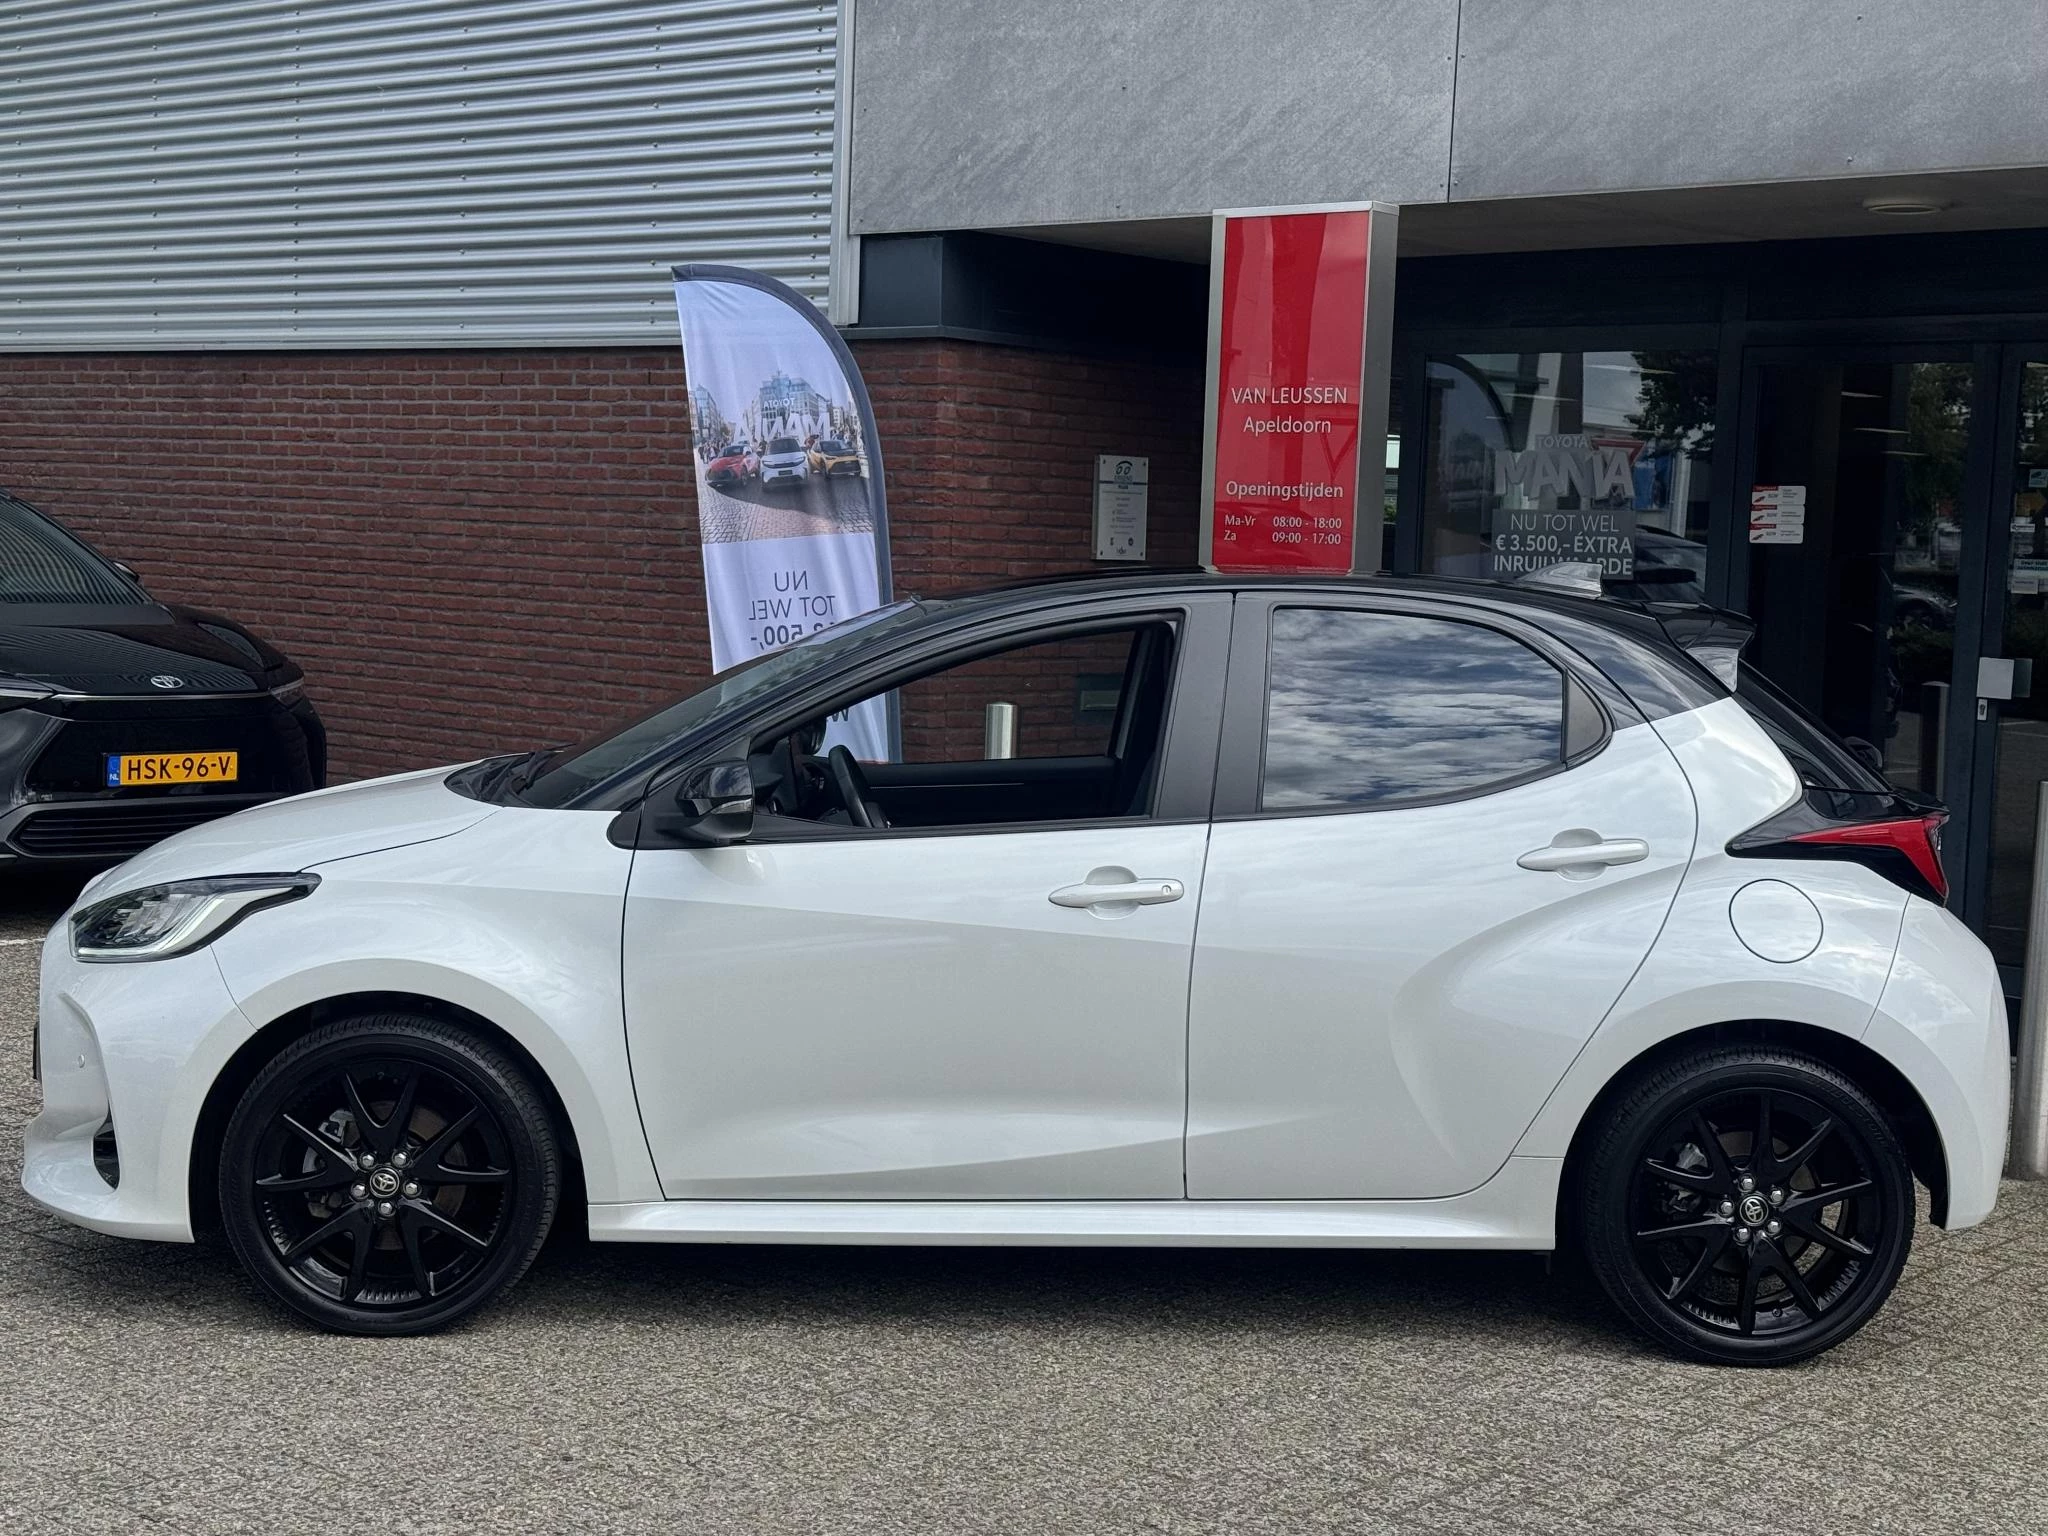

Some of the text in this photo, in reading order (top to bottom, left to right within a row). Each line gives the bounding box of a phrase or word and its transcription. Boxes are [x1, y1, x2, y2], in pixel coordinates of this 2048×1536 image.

[1231, 387, 1347, 404] VAN LEUSSEN
[1243, 416, 1331, 436] Apeldoorn
[1536, 435, 1589, 448] TOYOTA
[1495, 450, 1635, 499] MANIA
[1226, 481, 1343, 500] Openingstijden
[1224, 514, 1256, 527] Ma-Vr
[1272, 516, 1303, 528] 08:00
[1313, 517, 1342, 529] 18:00
[1510, 514, 1620, 532] NU TOT WEL
[1224, 530, 1237, 541] Za
[1272, 531, 1301, 544] 09:00
[1312, 532, 1342, 545] 17:00
[1496, 534, 1506, 550] €
[1573, 532, 1632, 554] ÉXTRA
[109, 756, 231, 781] NL HSK-96-V
